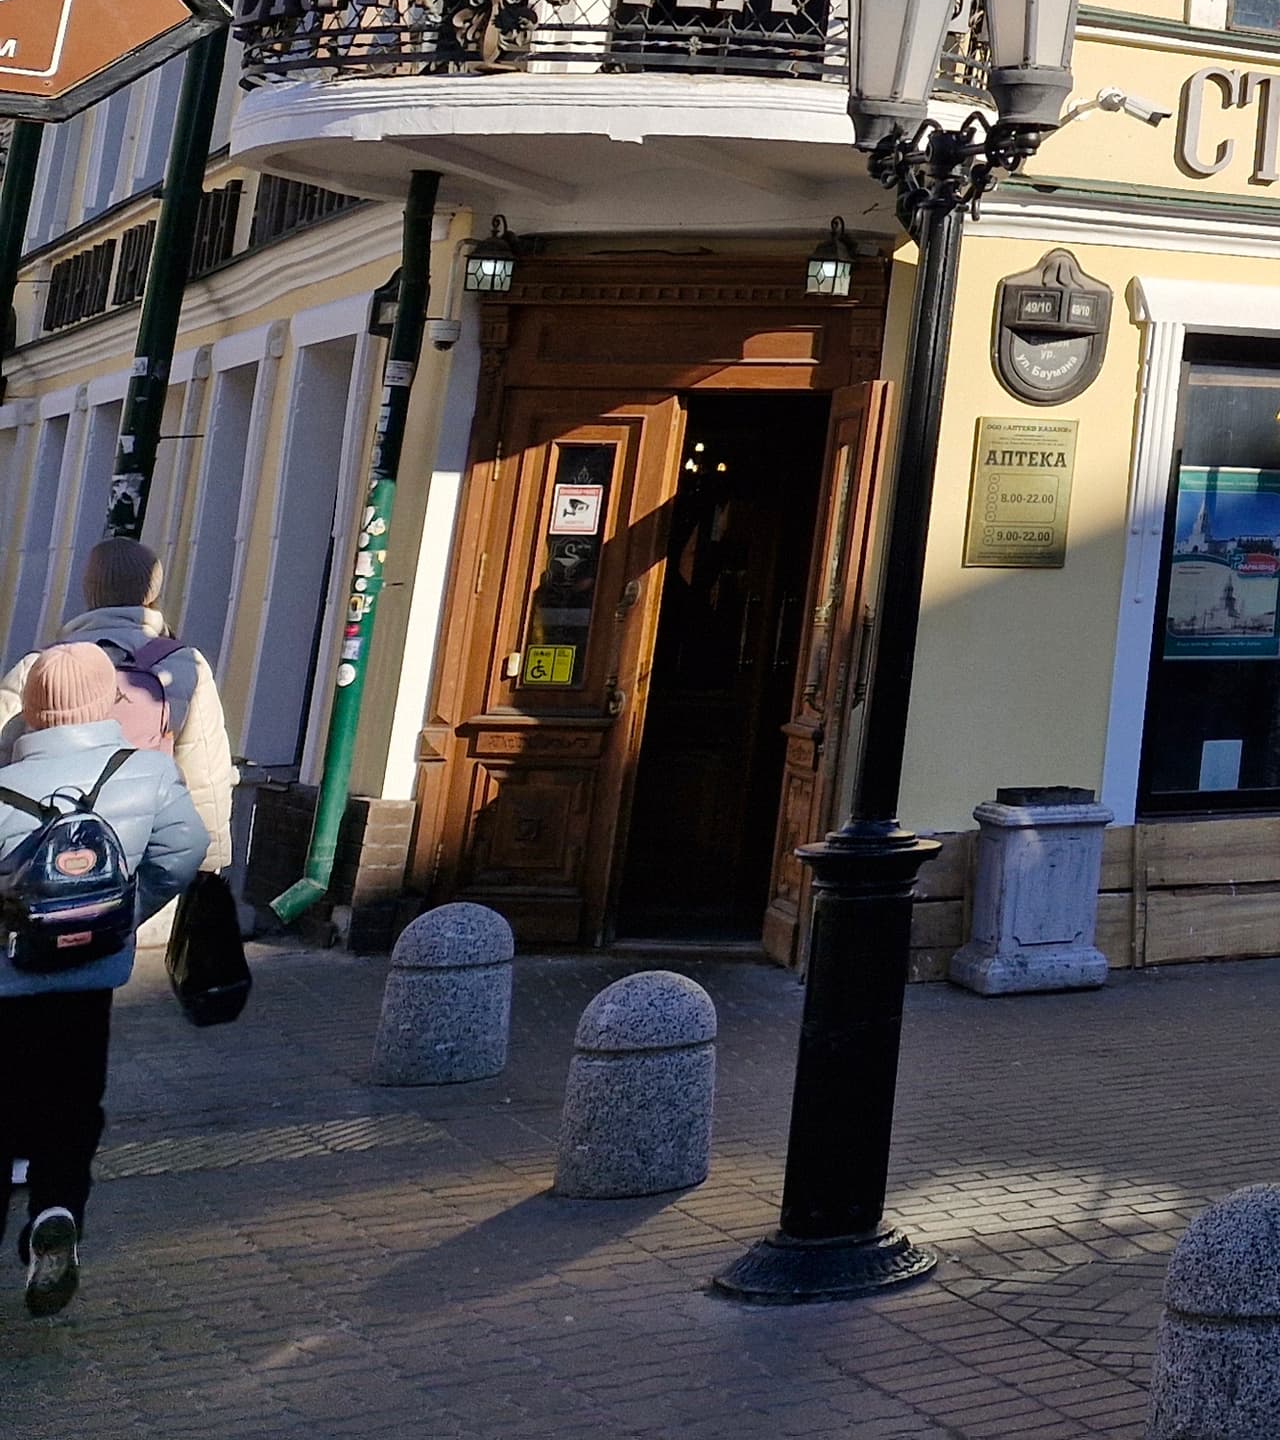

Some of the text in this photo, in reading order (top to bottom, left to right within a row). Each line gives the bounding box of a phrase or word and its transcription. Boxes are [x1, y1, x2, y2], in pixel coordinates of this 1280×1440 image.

[1024, 301, 1052, 314] 49/10
[1015, 353, 1078, 381] ул. Баумана
[984, 449, 1068, 468] АПТЕКА
[1000, 493, 1054, 504] 8.00-22.00
[996, 530, 1050, 542] 9.00-22.00
